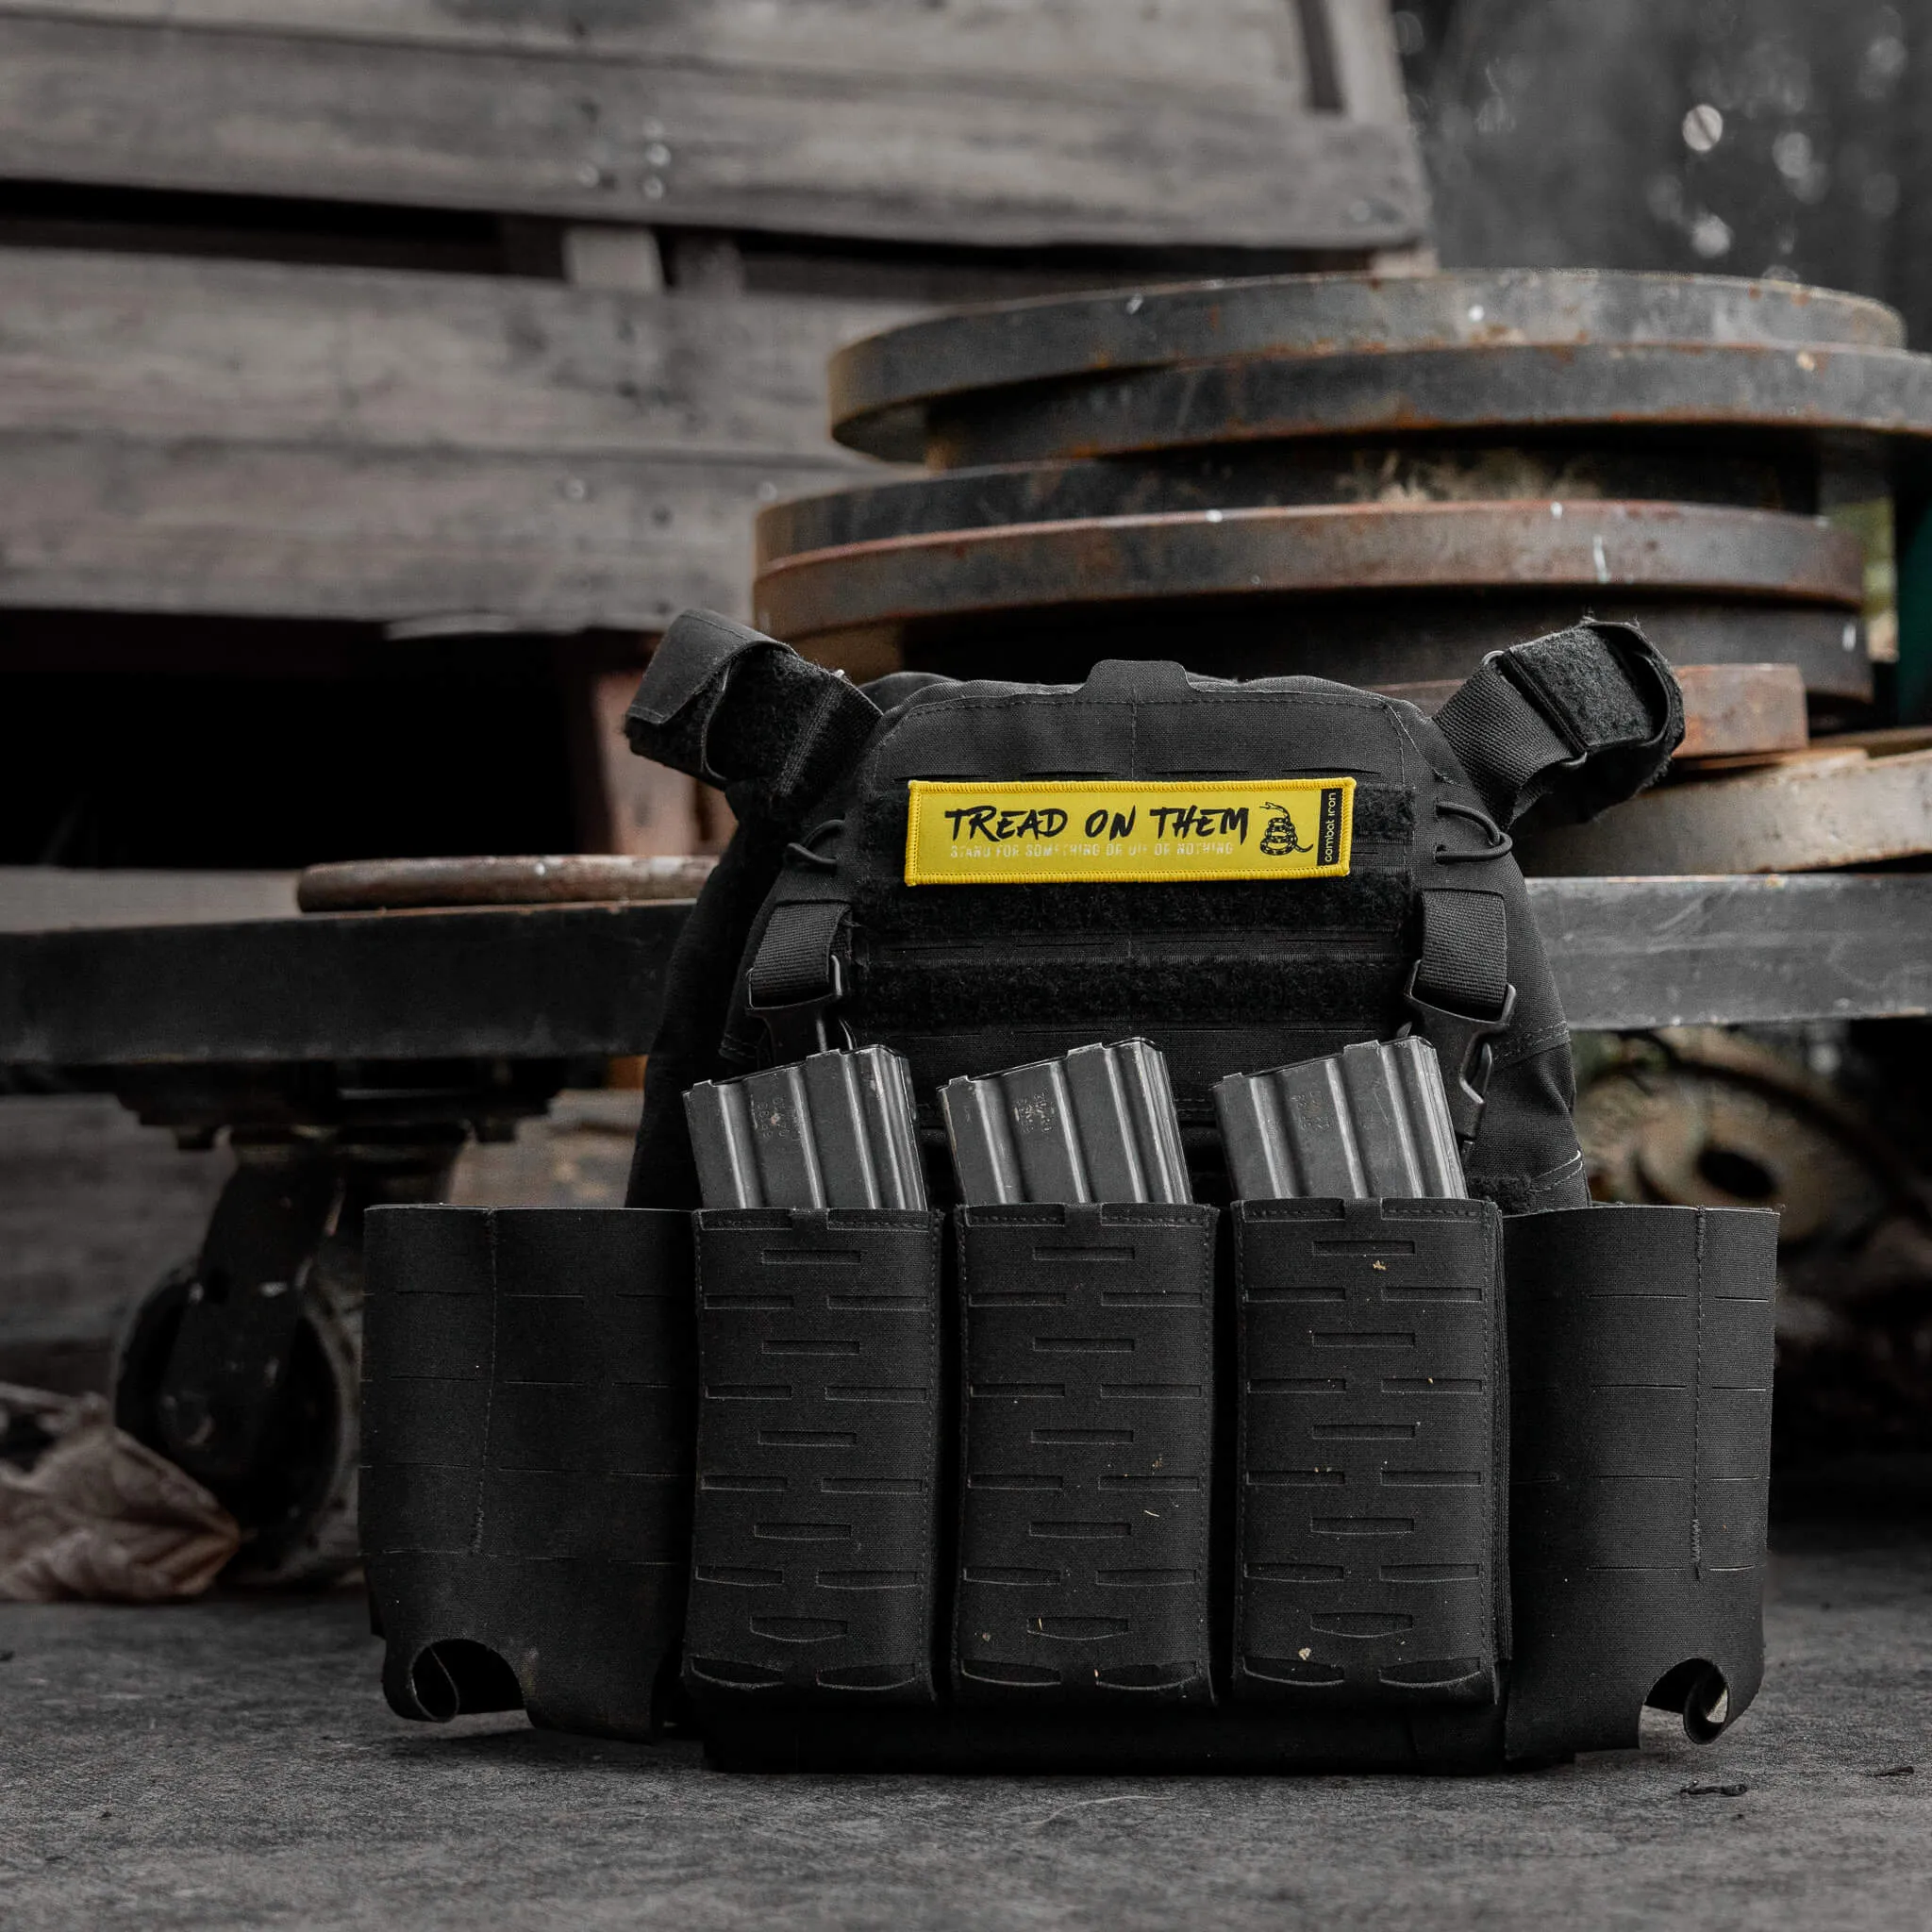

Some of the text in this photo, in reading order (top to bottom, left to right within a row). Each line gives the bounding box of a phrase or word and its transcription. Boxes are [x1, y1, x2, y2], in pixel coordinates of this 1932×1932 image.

[944, 805, 1249, 845] TREAD ON THEM
[1324, 792, 1337, 862] combat iron
